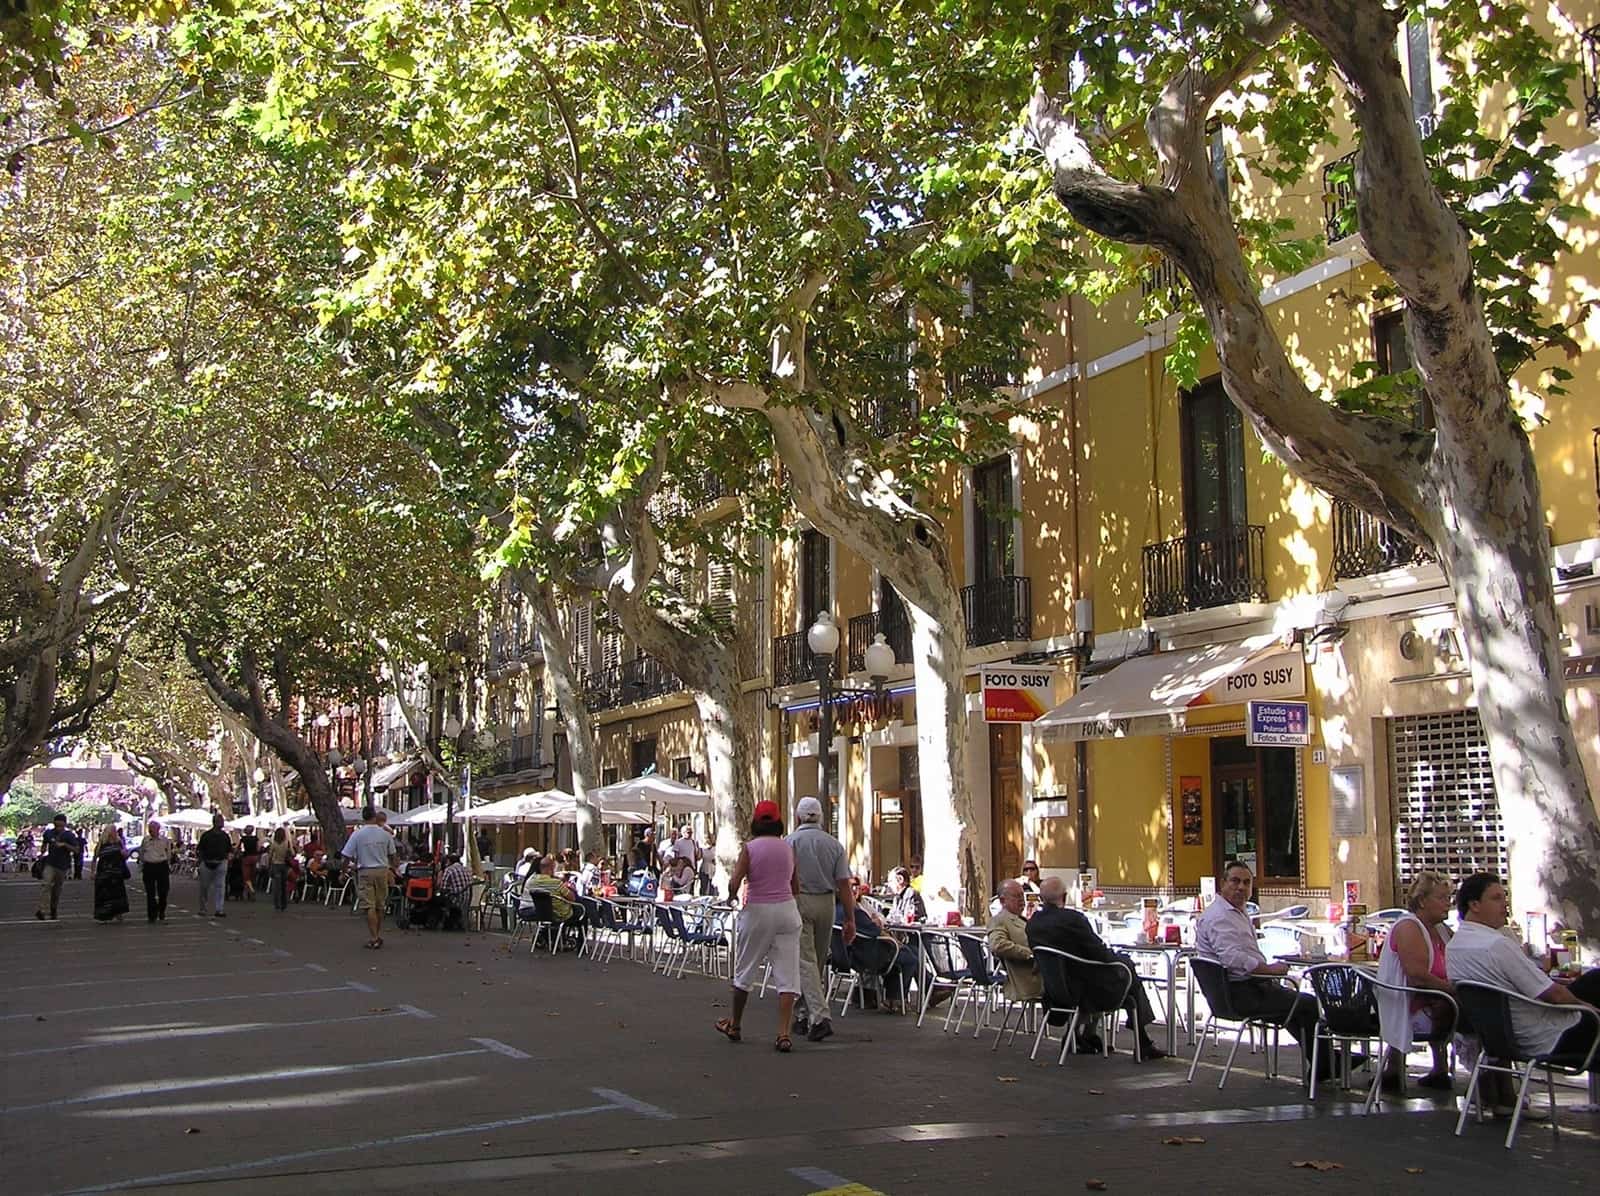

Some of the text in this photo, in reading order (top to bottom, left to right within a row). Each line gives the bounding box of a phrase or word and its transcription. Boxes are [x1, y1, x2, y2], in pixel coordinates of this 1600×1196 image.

[985, 674, 1050, 687] FOTO SUSY
[1227, 667, 1293, 691] FOTO SUSY
[1258, 705, 1286, 716] Estudio
[1257, 713, 1286, 723] Express
[1082, 721, 1105, 736] FOTO
[1257, 734, 1303, 743] Fotos Carnet
